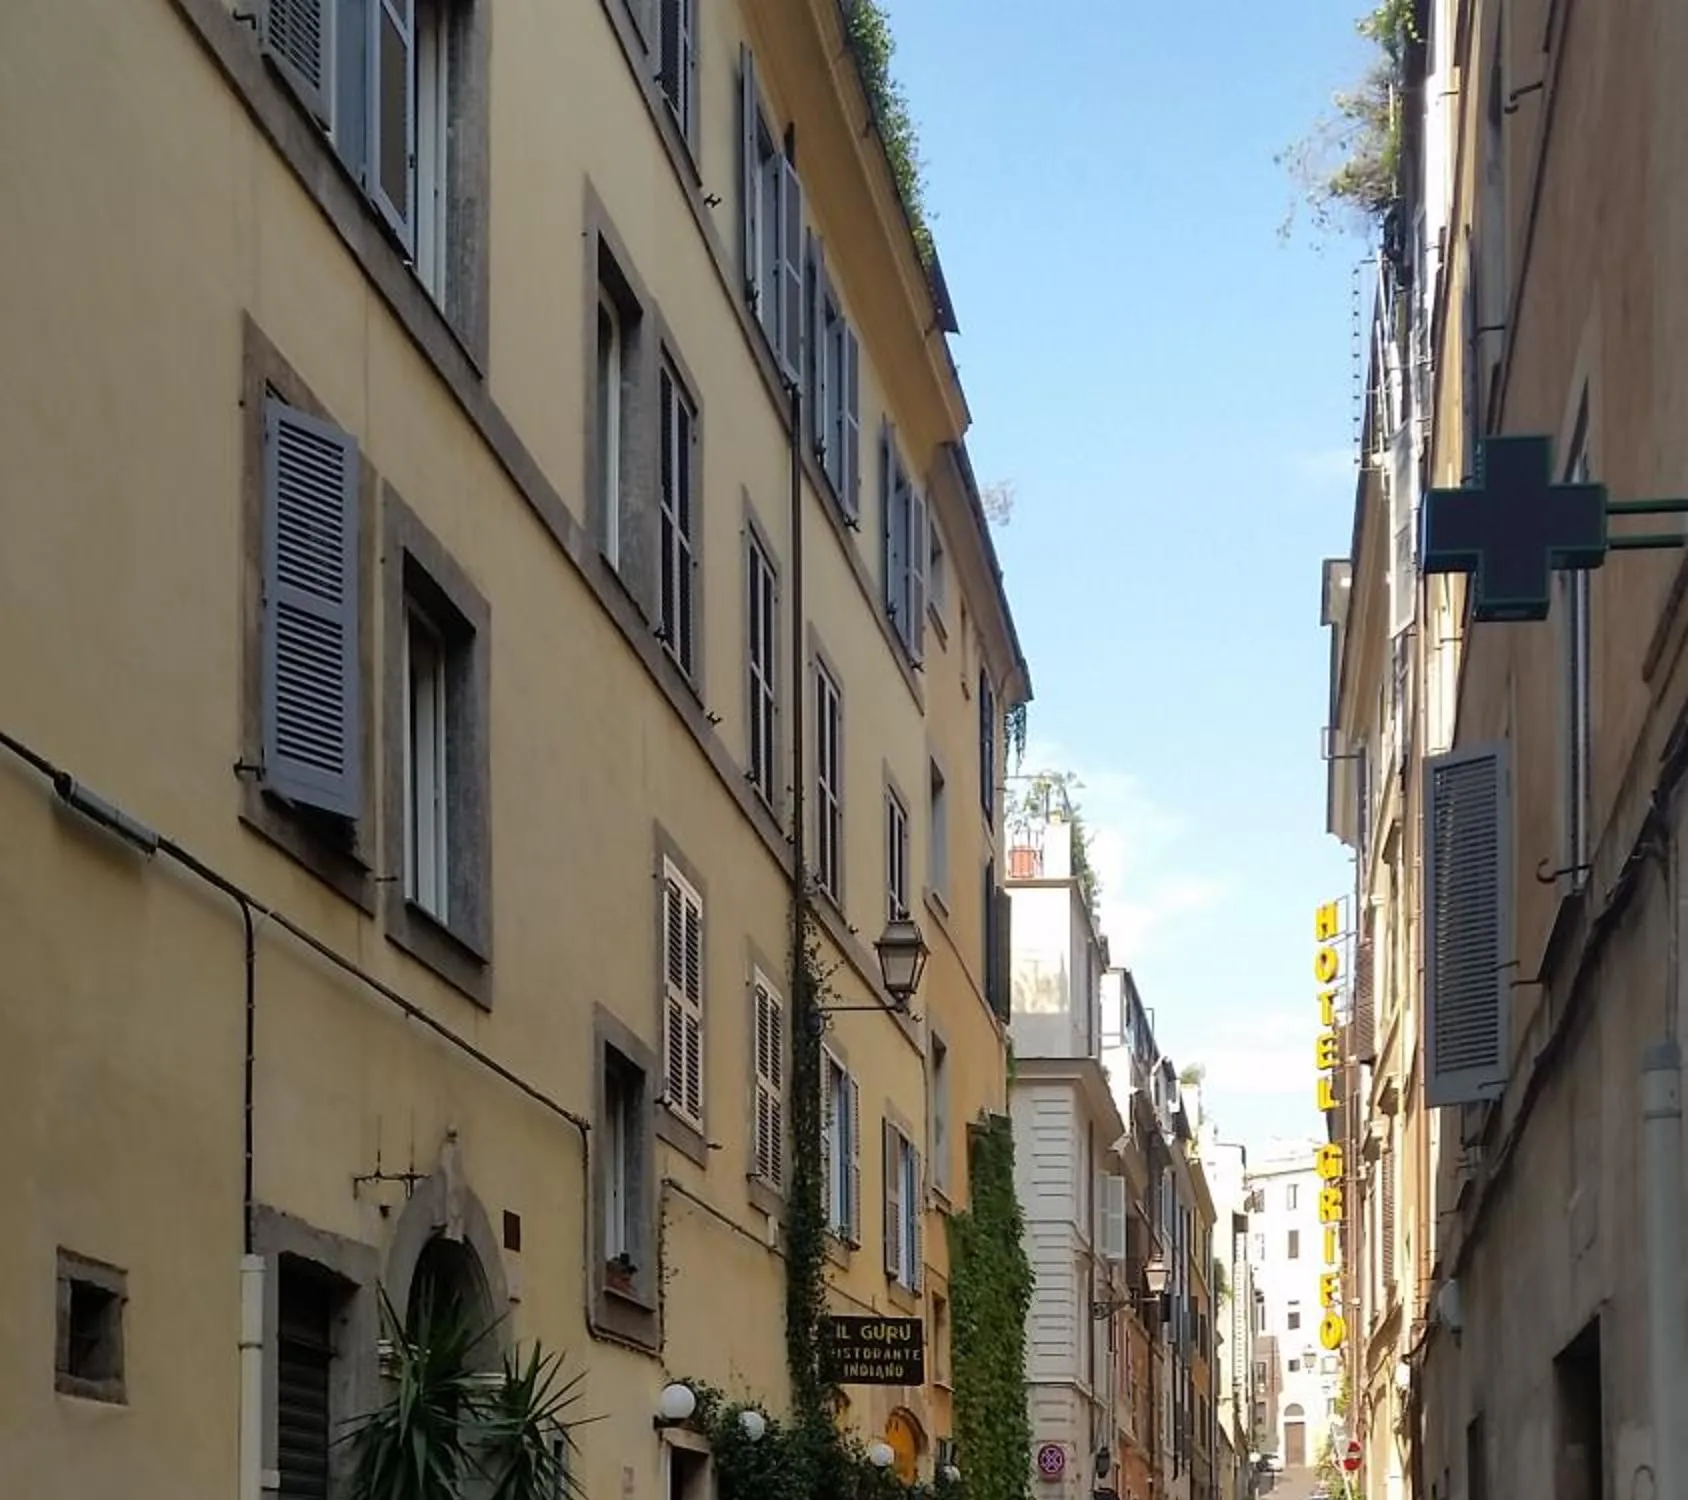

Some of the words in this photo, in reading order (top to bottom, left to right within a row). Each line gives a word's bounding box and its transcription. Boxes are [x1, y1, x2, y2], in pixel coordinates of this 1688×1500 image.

[1314, 901, 1340, 1112] HOTEL
[836, 1323, 851, 1339] IL
[861, 1323, 911, 1344] GURU
[843, 1362, 904, 1379] INDIANO
